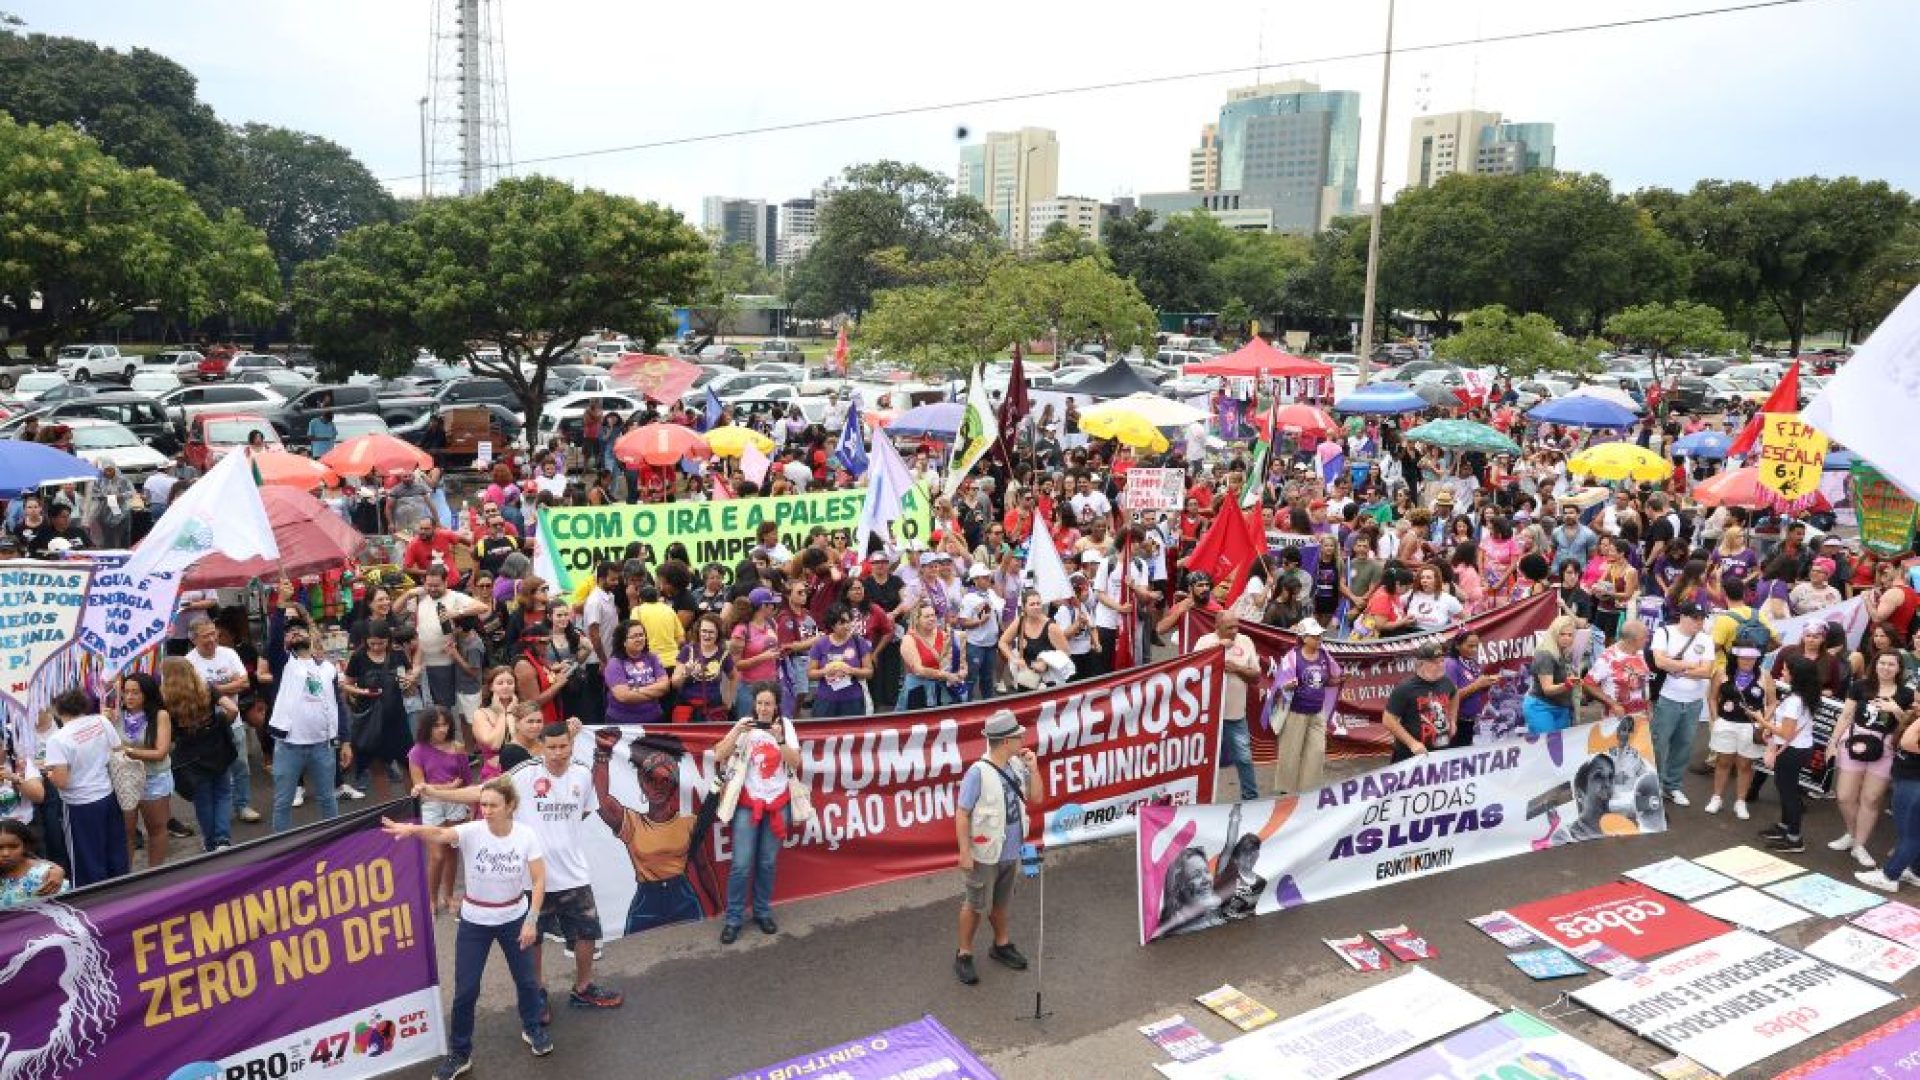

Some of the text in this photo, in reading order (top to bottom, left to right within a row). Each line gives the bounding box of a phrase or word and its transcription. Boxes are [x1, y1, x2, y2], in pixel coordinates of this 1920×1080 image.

[1761, 444, 1823, 466] ESCALA
[551, 490, 919, 540] COM O IRÃ E A PALESTA
[558, 544, 658, 572] CONTA
[1476, 634, 1536, 665] ASCISM
[679, 665, 1213, 820] NHUMA MENOS!
[1049, 730, 1209, 797] FEMINICÍDIO.
[1316, 746, 1522, 810] A PARLAMENTAR
[1362, 782, 1478, 826] DE TODAS
[1328, 803, 1505, 861] AS LUTAS
[132, 857, 396, 974] FEMINICÍDIO
[1554, 900, 1667, 939] cebes
[139, 904, 415, 1028] ZERO NO DF!!
[1753, 1006, 1821, 1039] cebes
[310, 1031, 349, 1065] 47
